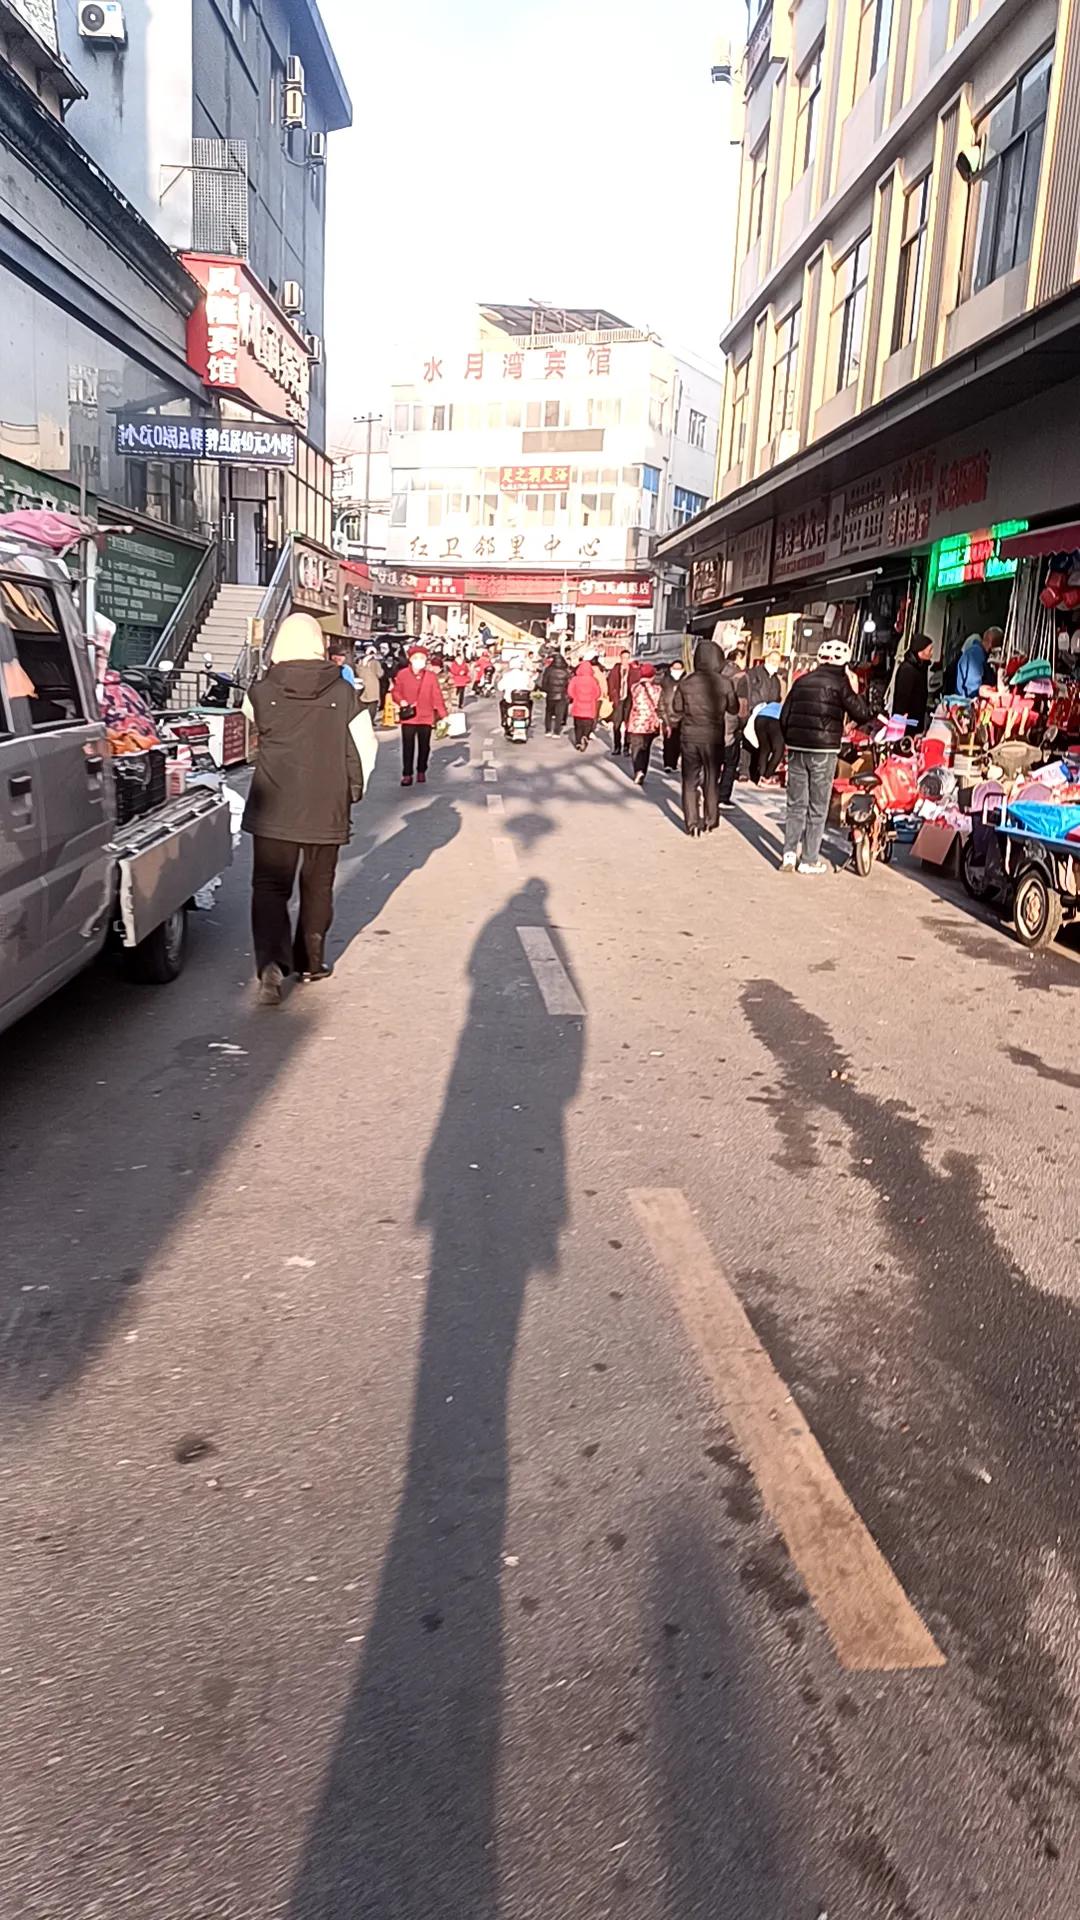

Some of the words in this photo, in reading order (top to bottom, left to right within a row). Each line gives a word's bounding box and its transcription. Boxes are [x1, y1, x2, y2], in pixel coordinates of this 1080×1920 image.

[423, 347, 611, 382] 水月湾宾馆
[409, 534, 600, 560] 红卫邻里中心
